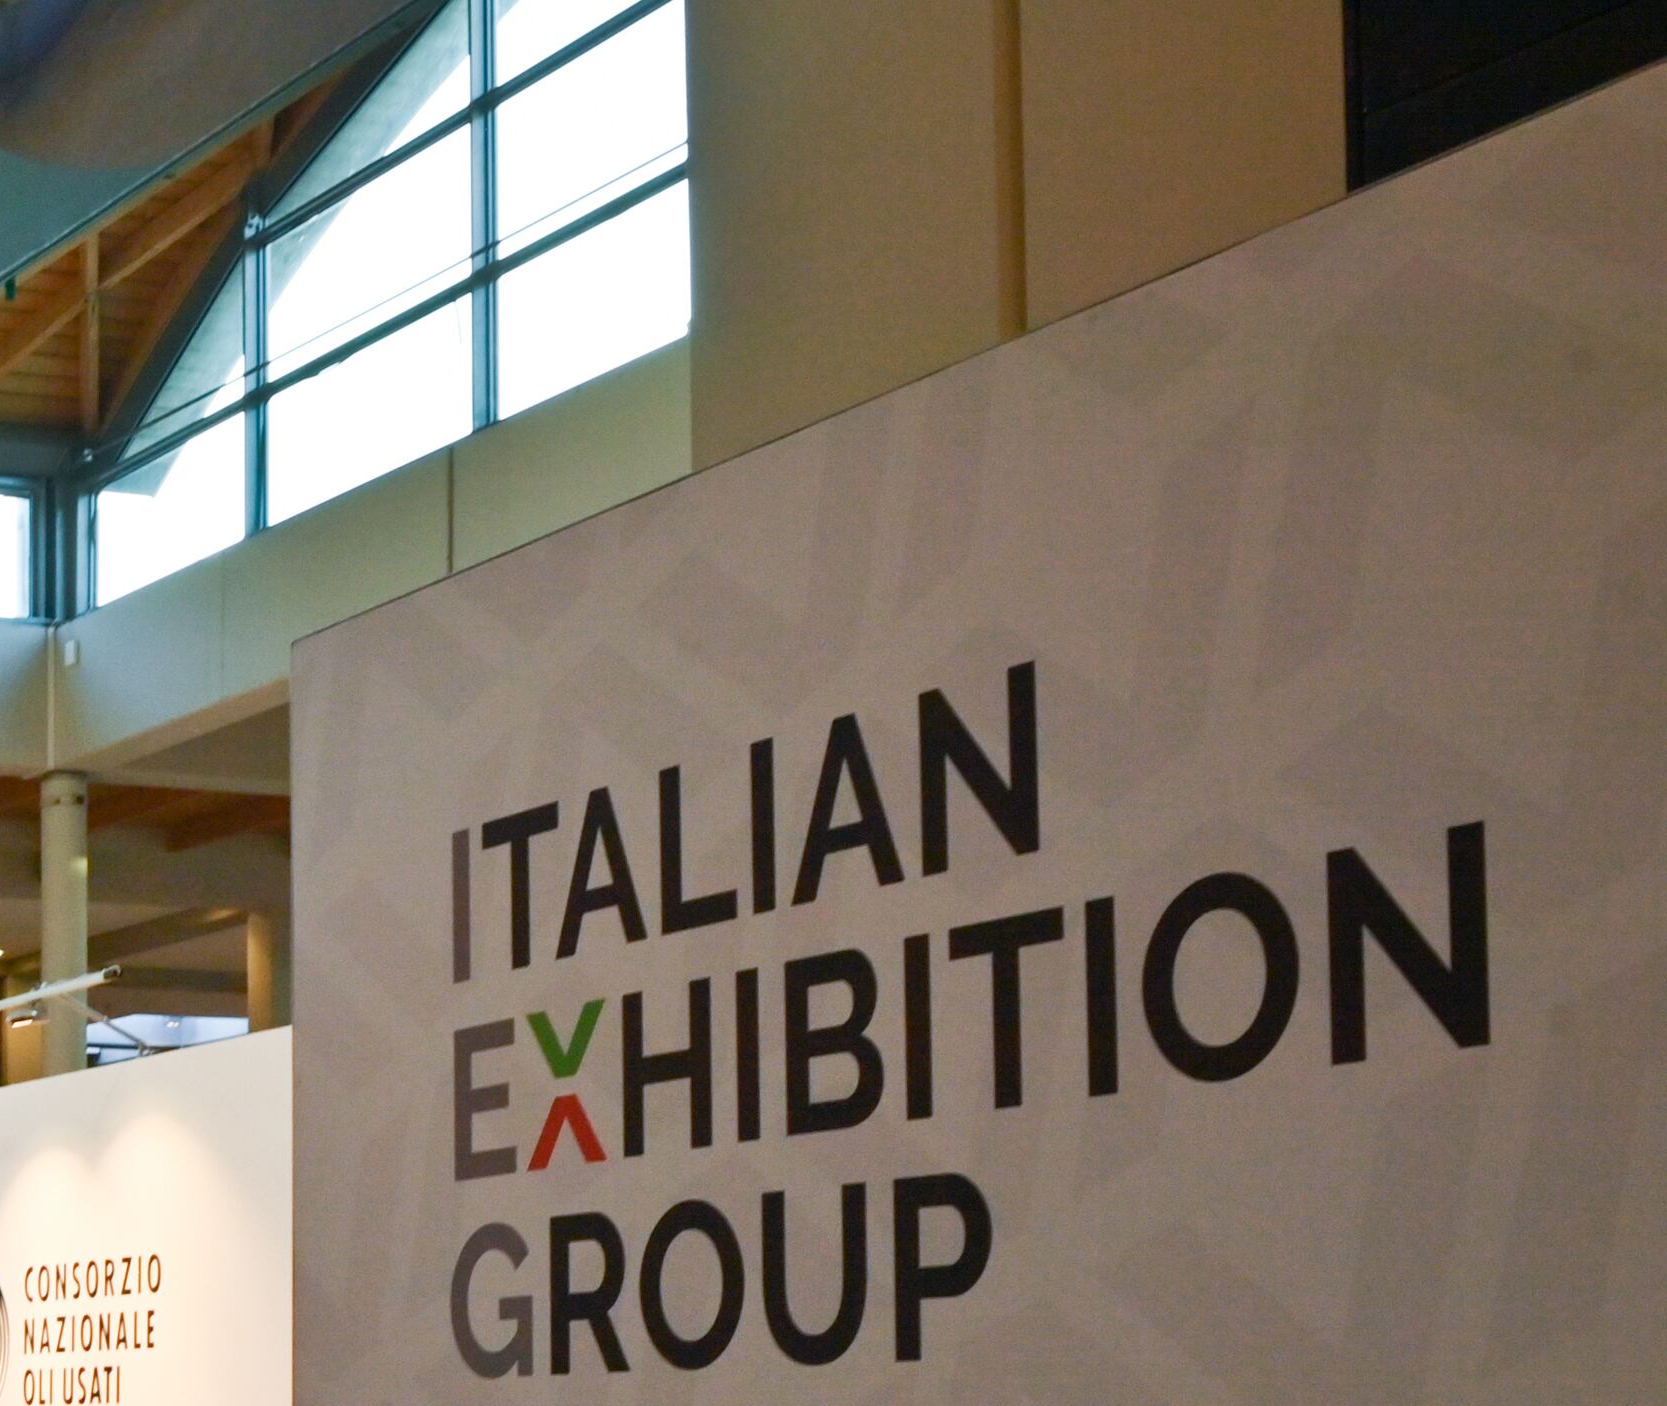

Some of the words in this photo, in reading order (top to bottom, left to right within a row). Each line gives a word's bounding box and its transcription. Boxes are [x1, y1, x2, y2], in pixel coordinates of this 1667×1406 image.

[451, 659, 1041, 984] ITALIAN
[452, 820, 1492, 1182] EXHIBITION
[24, 1253, 162, 1302] CONSORZIO
[24, 1310, 155, 1354] NAZIONALE
[450, 1172, 994, 1379] GROUP
[23, 1369, 53, 1405] OLI
[63, 1366, 121, 1405] USATI
